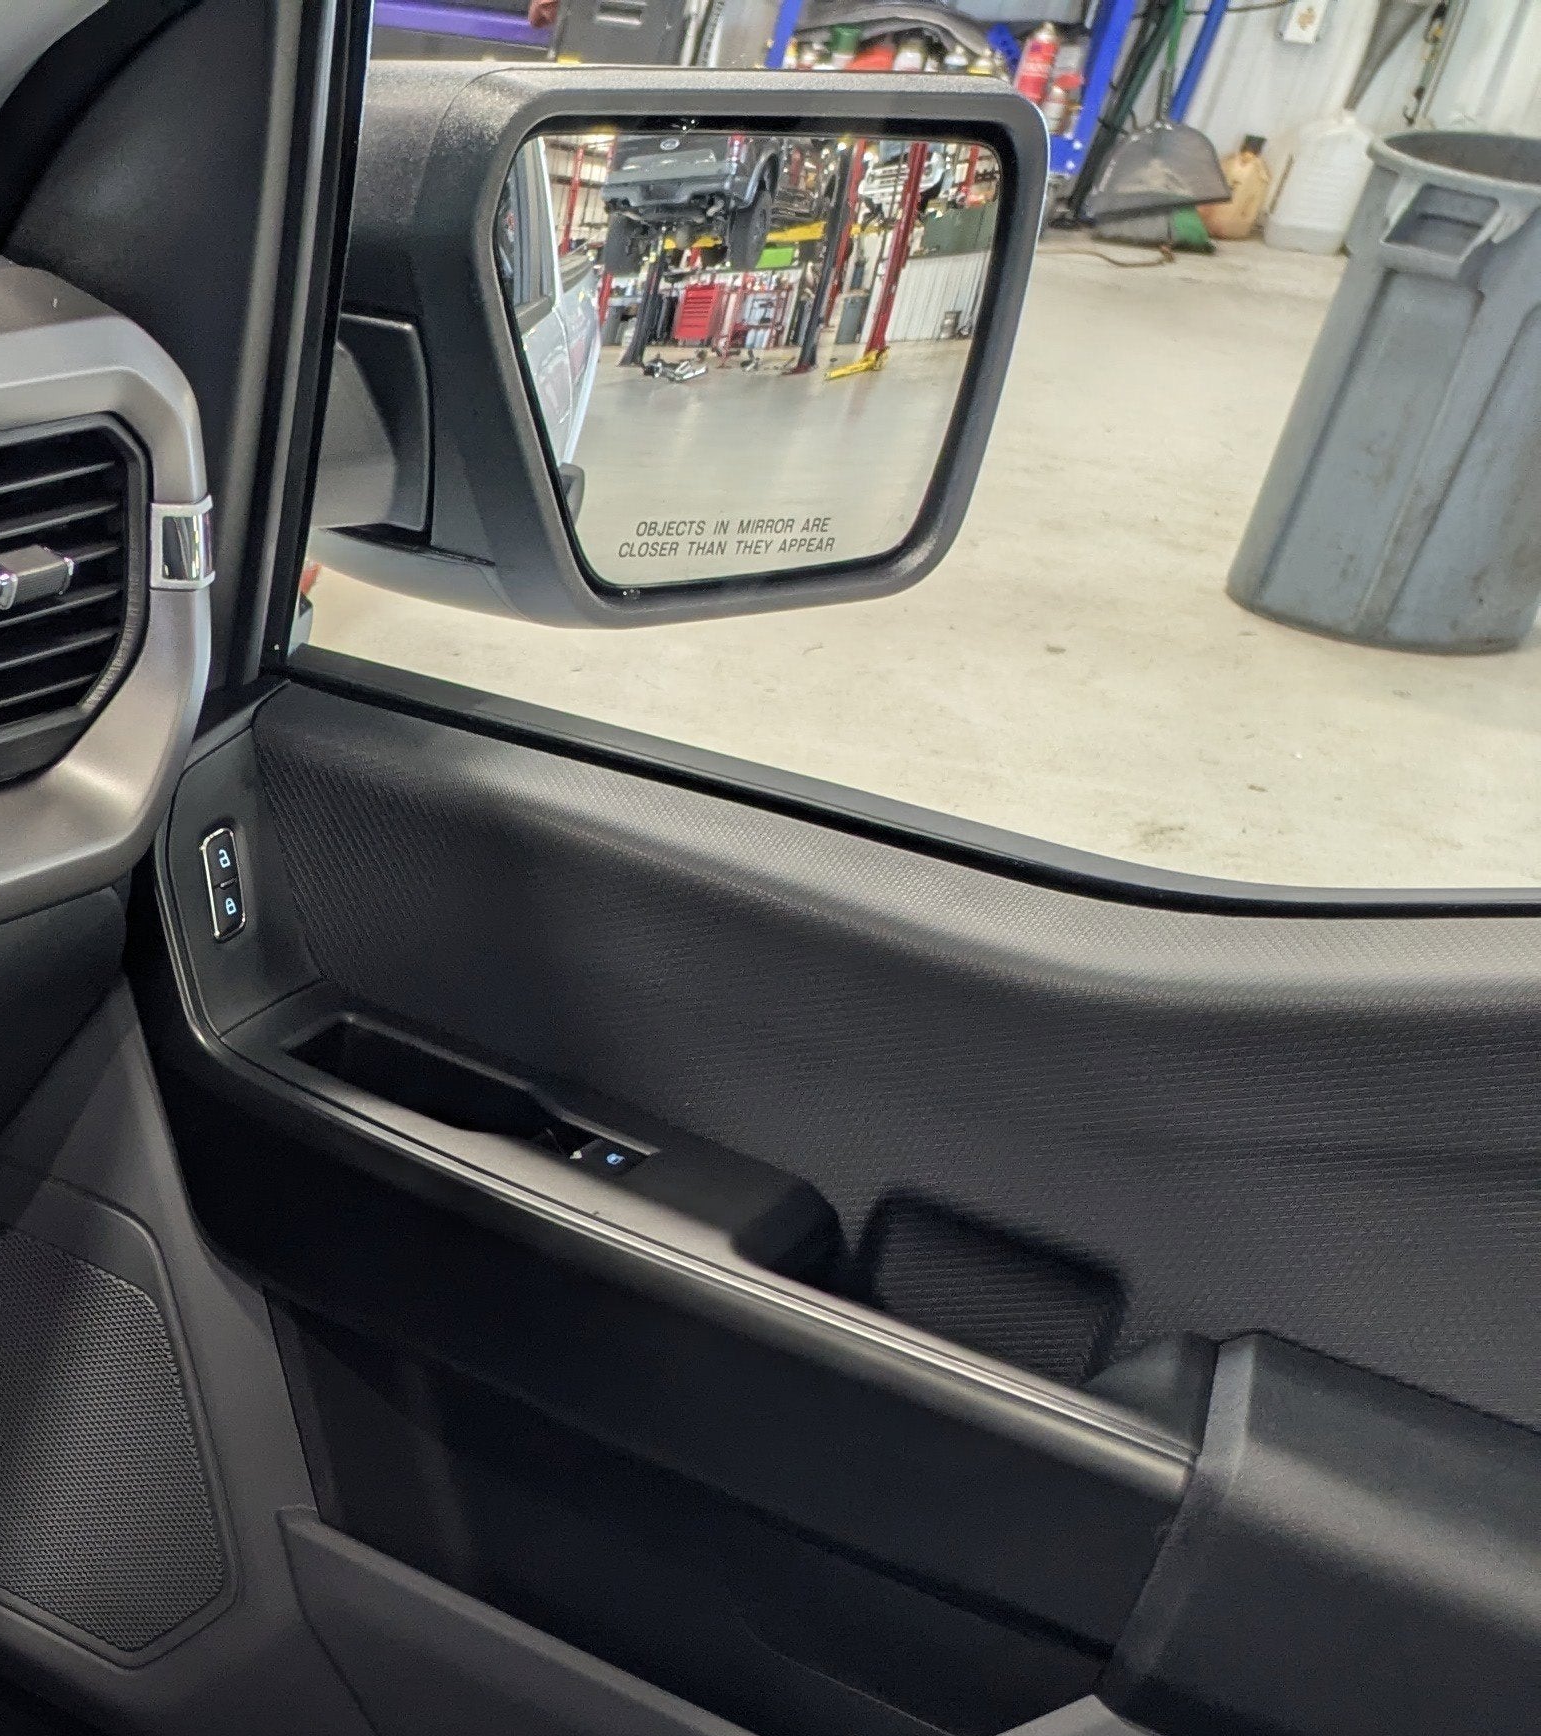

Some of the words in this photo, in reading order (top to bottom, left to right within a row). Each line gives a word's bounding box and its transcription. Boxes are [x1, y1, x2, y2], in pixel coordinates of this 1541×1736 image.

[635, 520, 706, 538] OBJECTS
[713, 519, 729, 536] IN
[736, 518, 796, 535] MIRROR
[801, 517, 832, 533] ARE
[617, 541, 679, 559] CLOSER
[688, 540, 727, 556] THAN
[736, 538, 774, 555] THEY
[777, 536, 836, 553] APPEAR
